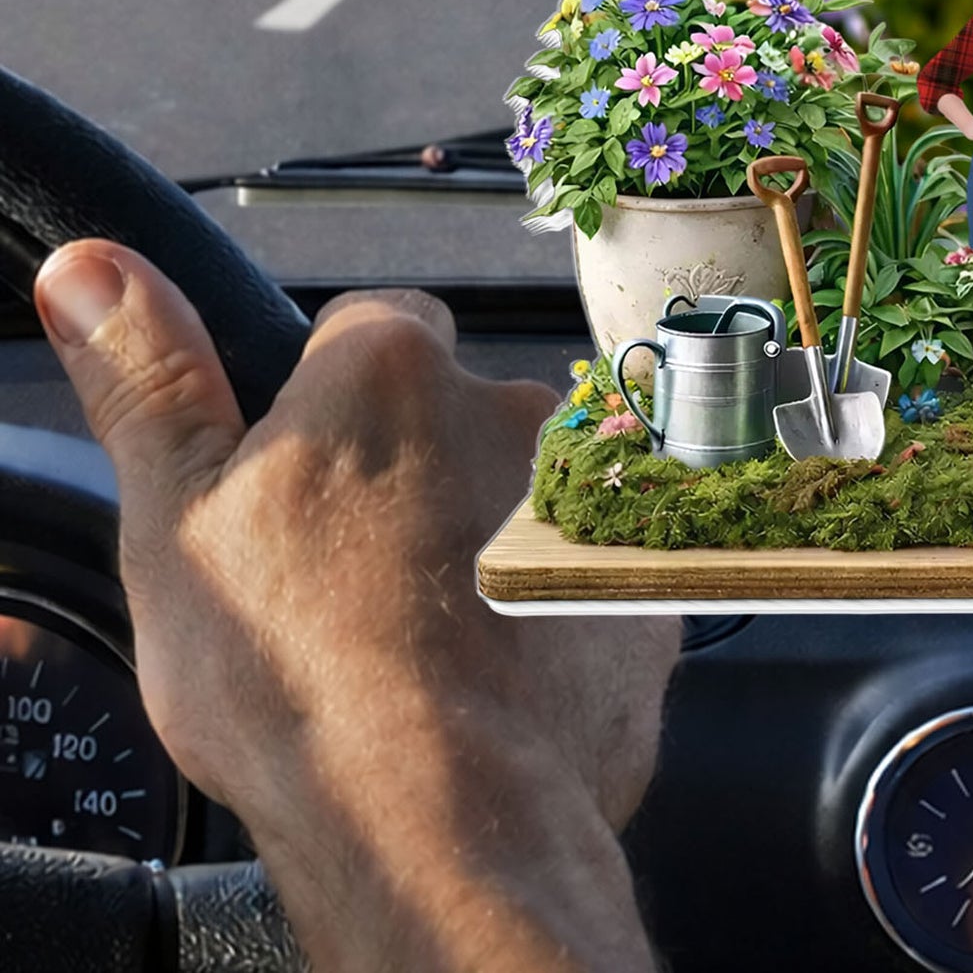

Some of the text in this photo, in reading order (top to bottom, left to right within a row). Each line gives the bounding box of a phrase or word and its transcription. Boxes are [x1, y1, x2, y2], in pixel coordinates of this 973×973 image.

[8, 695, 51, 724] 100
[53, 733, 97, 762] 120
[74, 789, 117, 817] 140
